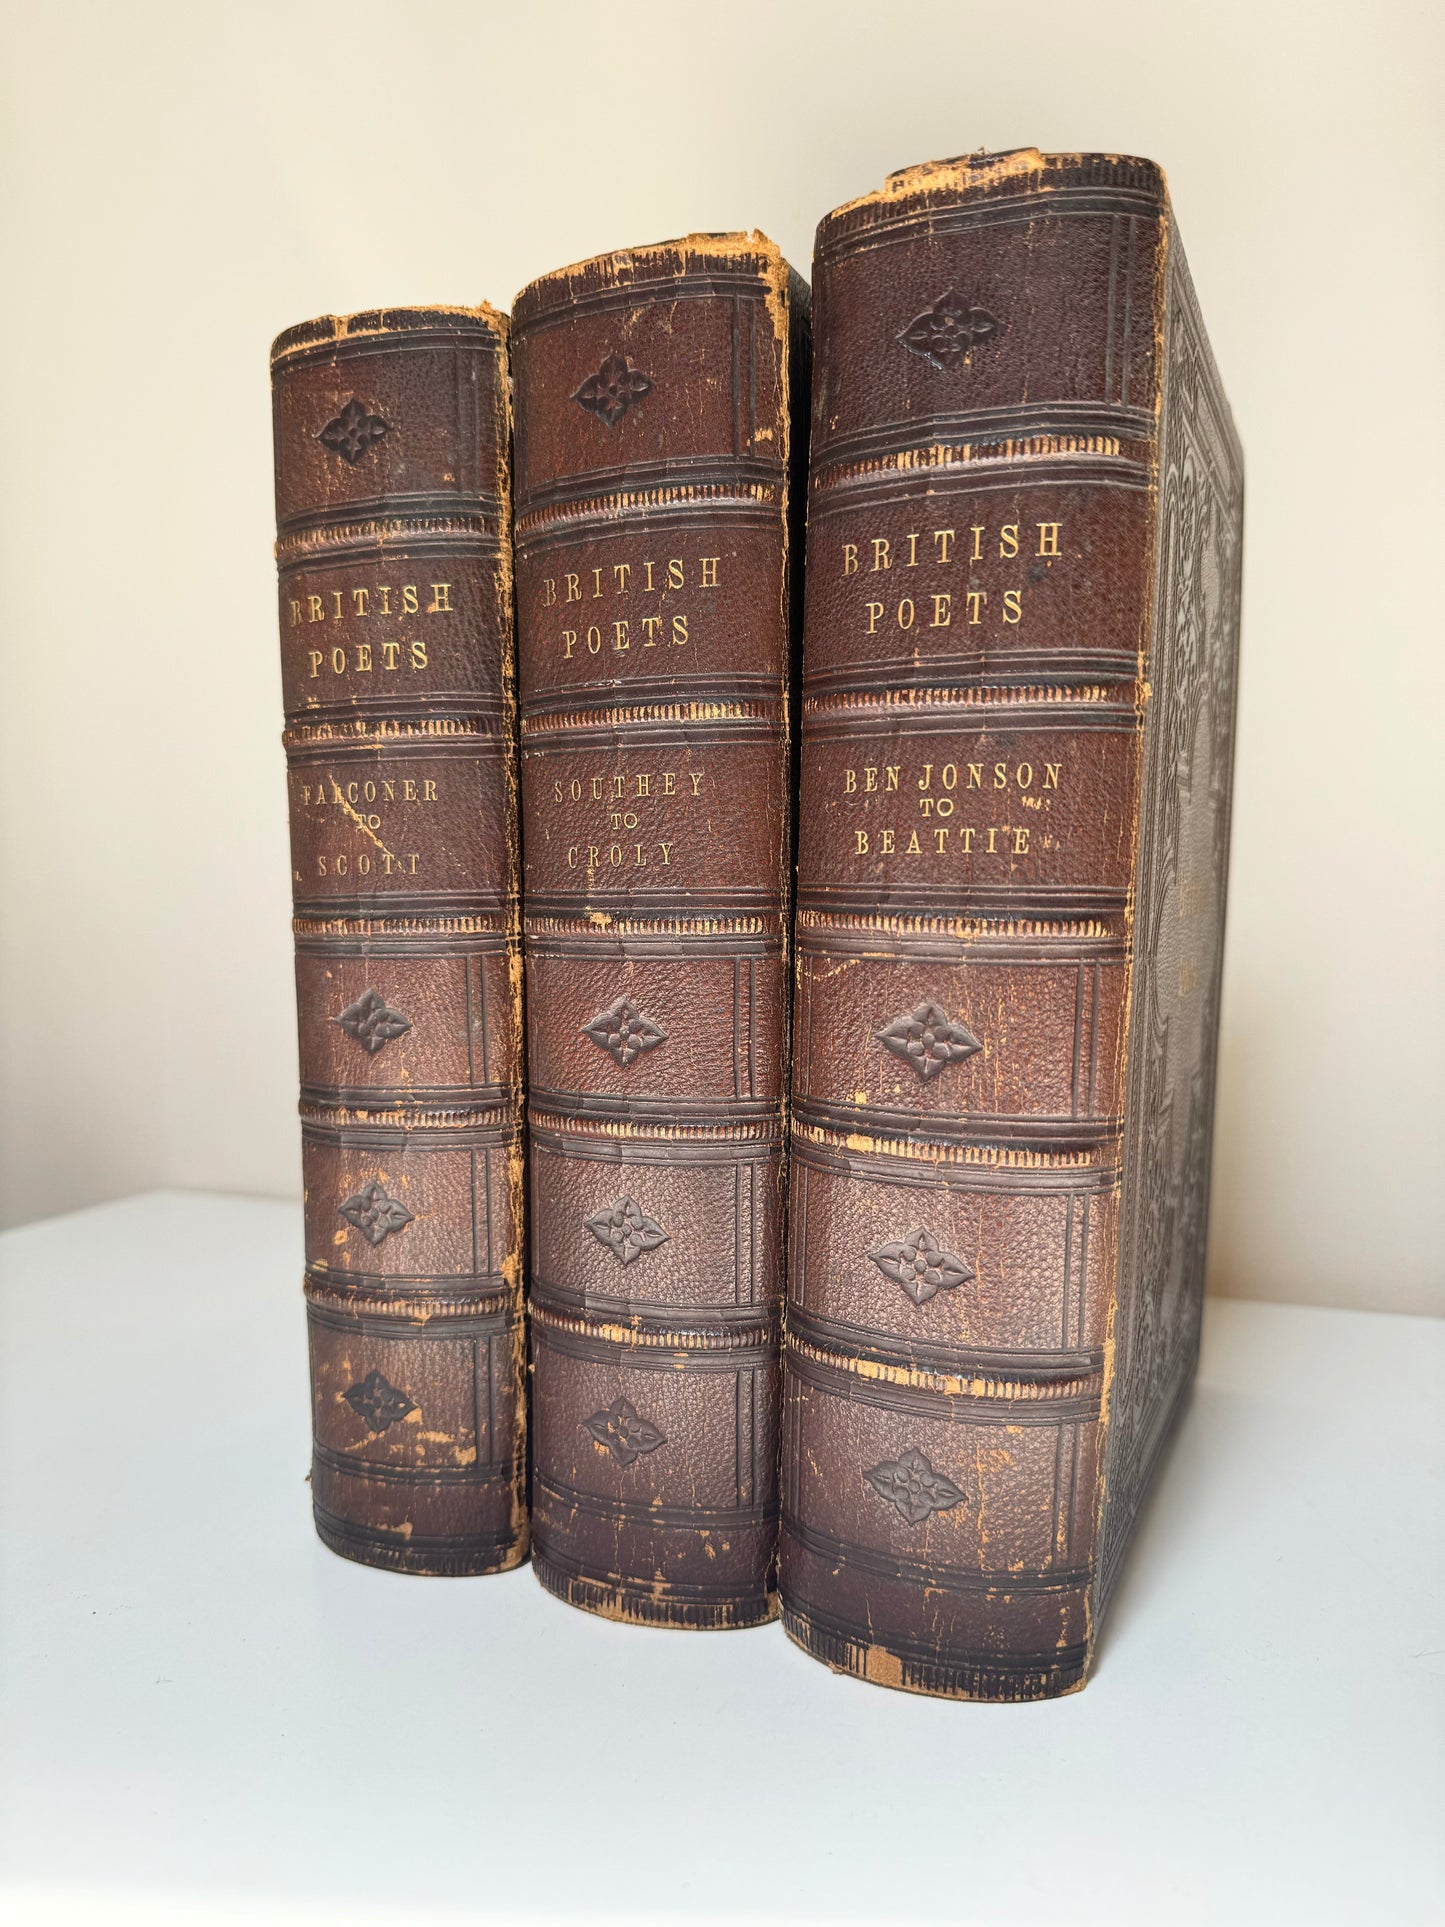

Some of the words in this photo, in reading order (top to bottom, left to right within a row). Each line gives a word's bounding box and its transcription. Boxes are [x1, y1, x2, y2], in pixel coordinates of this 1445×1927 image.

[841, 522, 1063, 576] BRITISH
[542, 557, 721, 608] BRITISH
[289, 583, 454, 628] BRITISH
[865, 590, 1023, 635] POETS
[562, 615, 690, 659] POETS
[309, 642, 430, 678] POETS
[301, 779, 439, 806] FALCONER
[553, 773, 704, 803] SOUTHEY
[843, 765, 902, 794] BEN
[917, 763, 1063, 791] JONSON
[355, 814, 381, 830] TO
[610, 813, 638, 830] TO
[919, 798, 955, 817] TO
[568, 843, 674, 869] CROLY
[854, 828, 1031, 855] BEATTIE
[318, 854, 421, 876] SCOTT
